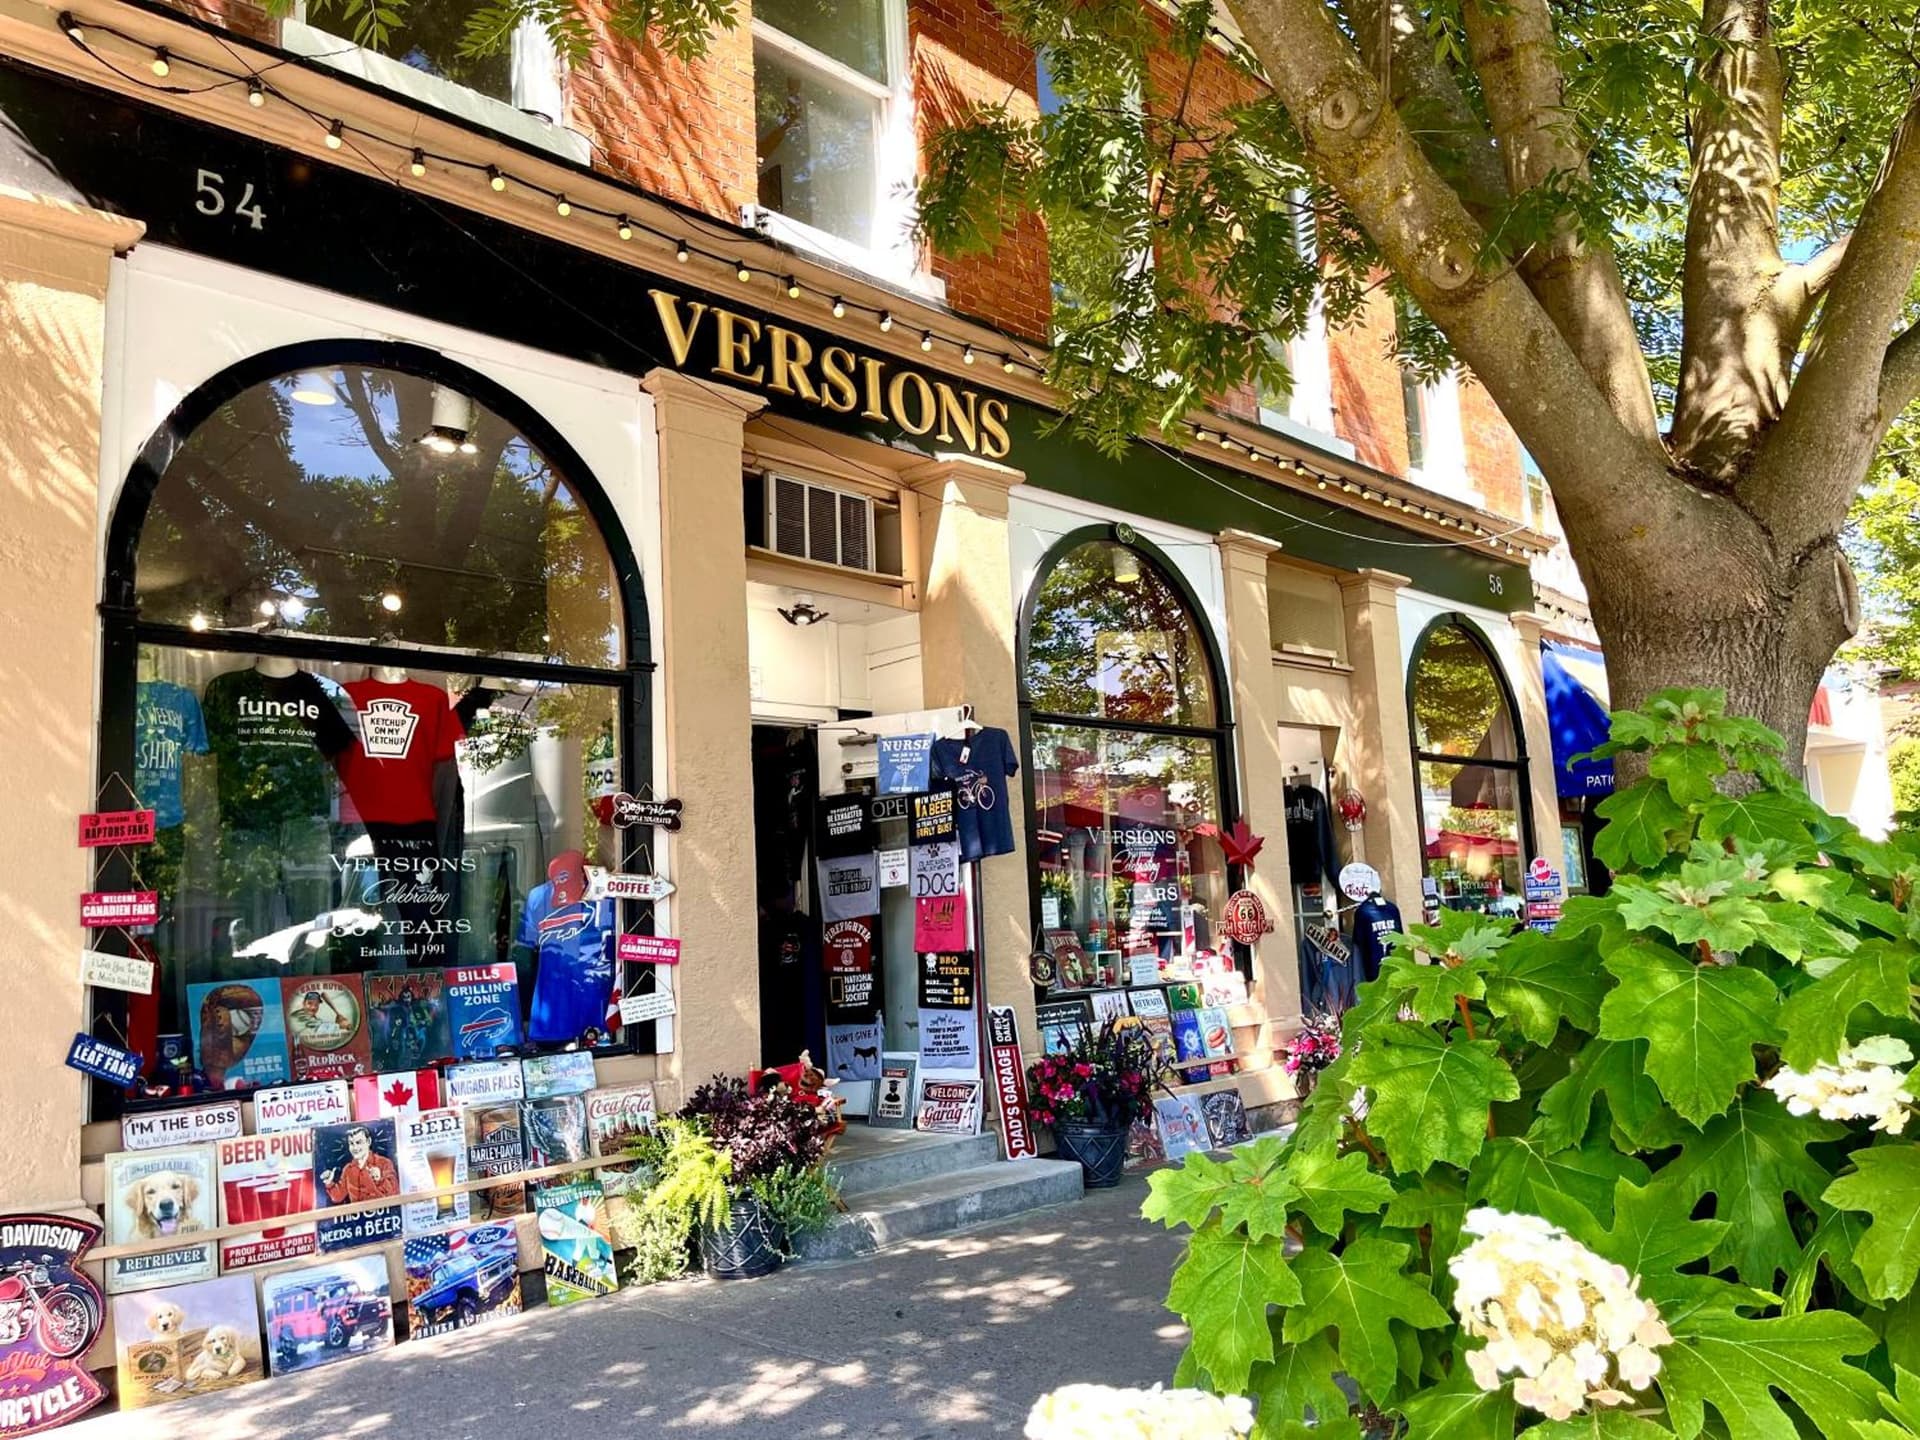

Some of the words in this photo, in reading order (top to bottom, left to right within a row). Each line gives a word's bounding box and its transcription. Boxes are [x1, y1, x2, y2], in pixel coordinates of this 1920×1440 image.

[195, 168, 267, 230] 54
[648, 289, 1011, 459] VERSIONS
[1488, 573, 1503, 595] 58
[237, 696, 320, 720] funcle
[382, 703, 402, 713] PUT
[370, 717, 407, 727] KETCHUP
[278, 728, 296, 738] only
[374, 727, 387, 735] ON
[387, 727, 400, 736] MY
[369, 735, 406, 746] KETCHUP
[881, 739, 930, 752] NURSE
[929, 799, 953, 816] BEER
[85, 825, 125, 839] RAPTORS
[127, 824, 149, 836] FANS
[1085, 826, 1177, 845] VERSIONS
[328, 853, 477, 873] VERSIONS
[607, 881, 650, 894] COFFEE
[916, 872, 955, 897] DOG
[362, 878, 451, 916] Celebrating
[1123, 886, 1178, 903] YARS
[83, 905, 131, 917] CANADIEN
[132, 903, 156, 916] FANS
[382, 918, 472, 936] YEARS
[360, 943, 418, 957] Established
[421, 943, 446, 955] 1991
[659, 947, 677, 957] FANS
[939, 956, 958, 965] BBQ
[457, 969, 501, 982] BILLS
[939, 967, 970, 976] TIMER
[450, 982, 512, 997] GRILLING
[464, 995, 501, 1006] ZONE
[855, 1030, 873, 1041] GIVE
[94, 1043, 126, 1060] WELCOME
[73, 1044, 104, 1067] LEAF
[104, 1055, 136, 1080] FANS
[997, 1048, 1018, 1104] GARAGE
[450, 1079, 491, 1097] NIAGARA
[492, 1075, 520, 1092] FALLS
[930, 1087, 971, 1098] WELCOME
[261, 1095, 345, 1119] MONTRÉAL
[923, 1105, 966, 1125] Garag
[131, 1121, 154, 1136] I'M
[160, 1115, 188, 1131] THE
[195, 1111, 236, 1127] BOSS
[1006, 1106, 1025, 1149] DAD'S
[222, 1142, 266, 1166] BEER
[319, 1227, 353, 1244] NEEDS
[355, 1226, 362, 1237] A
[363, 1217, 401, 1237] BEER
[474, 1229, 501, 1244] Ford
[229, 1247, 256, 1257] PROOF
[259, 1242, 280, 1251] THAT
[281, 1236, 314, 1248] SPORTS
[126, 1249, 201, 1271] RETRIEVER
[229, 1256, 246, 1267] AND
[247, 1251, 283, 1264] ALCOHOL
[285, 1249, 295, 1257] DO
